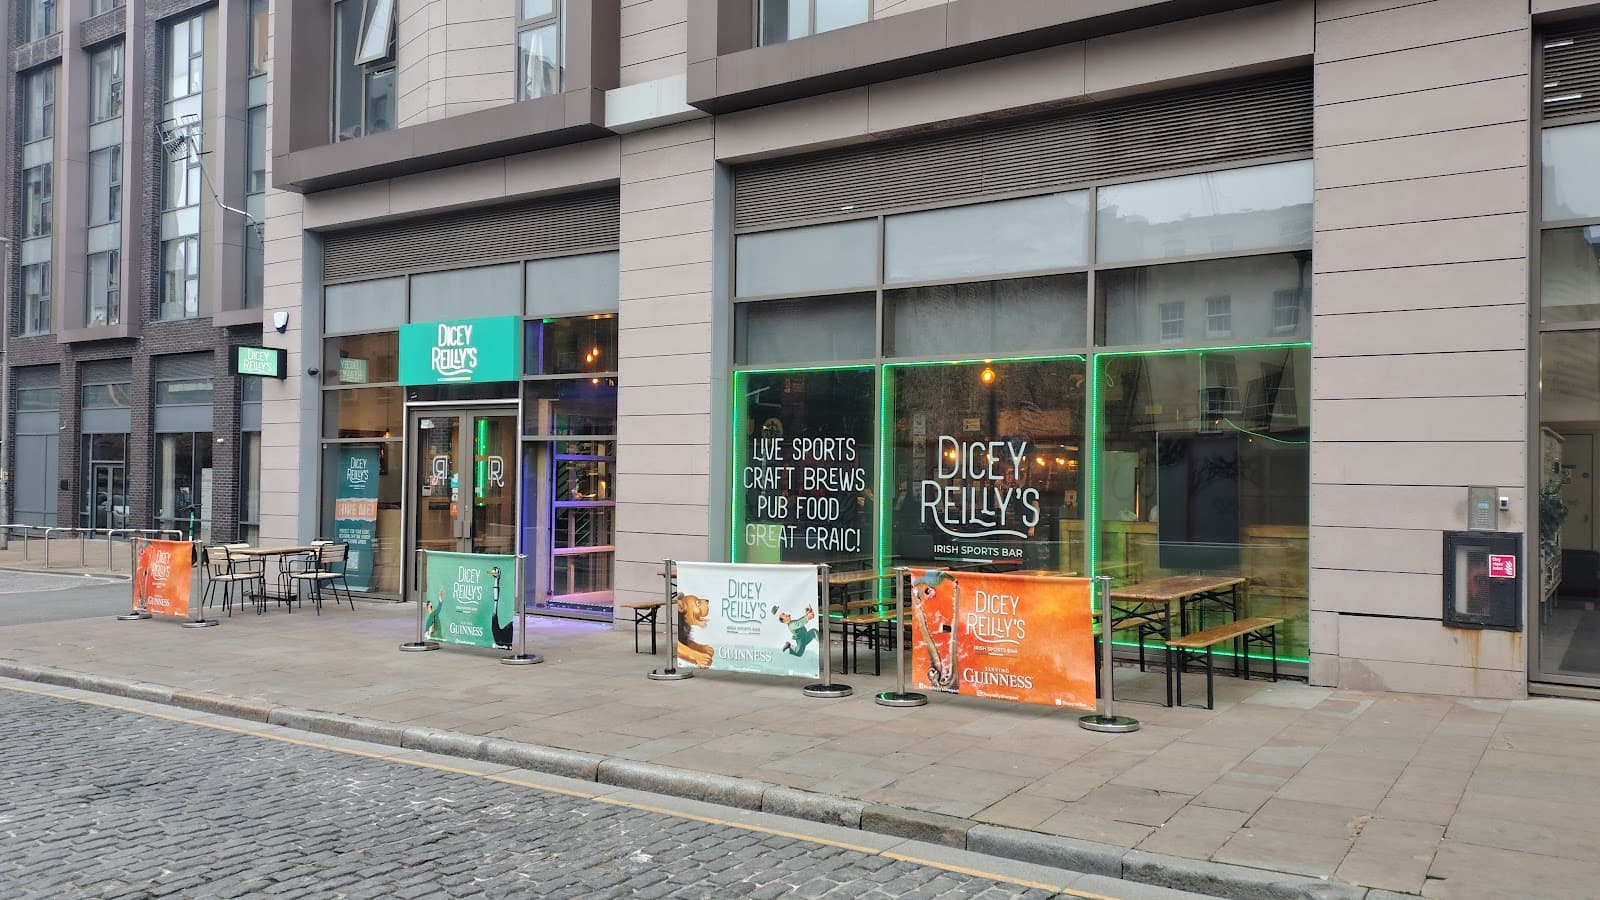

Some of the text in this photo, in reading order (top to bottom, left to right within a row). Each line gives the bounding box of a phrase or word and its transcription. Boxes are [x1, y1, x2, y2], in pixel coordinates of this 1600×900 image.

[438, 323, 473, 346] DICEY
[247, 349, 270, 361] DICEY
[432, 346, 478, 375] REILLY'S
[752, 437, 856, 461] LIVE SPORTS
[938, 435, 1027, 480] DICEY
[351, 457, 367, 469] DICEY
[347, 468, 369, 483] REILLY'S
[743, 466, 865, 492] CRAFT BREWS
[757, 495, 840, 521] PUB FOOD
[920, 480, 1040, 539] REILLY'S
[745, 523, 861, 552] GREAT CRAIC!
[934, 544, 1024, 558] IRISH SPORTS BAR
[458, 566, 481, 584] DICEY
[453, 582, 483, 605] REILLY'S
[728, 578, 762, 600] DICEY
[721, 598, 767, 624] REILLY'S
[975, 590, 1020, 616] DICEY
[449, 622, 484, 637] GUINNESS
[966, 612, 1025, 645] REILLY'S
[719, 646, 772, 663] GUINNESS
[963, 667, 1033, 690] GUINNESS
